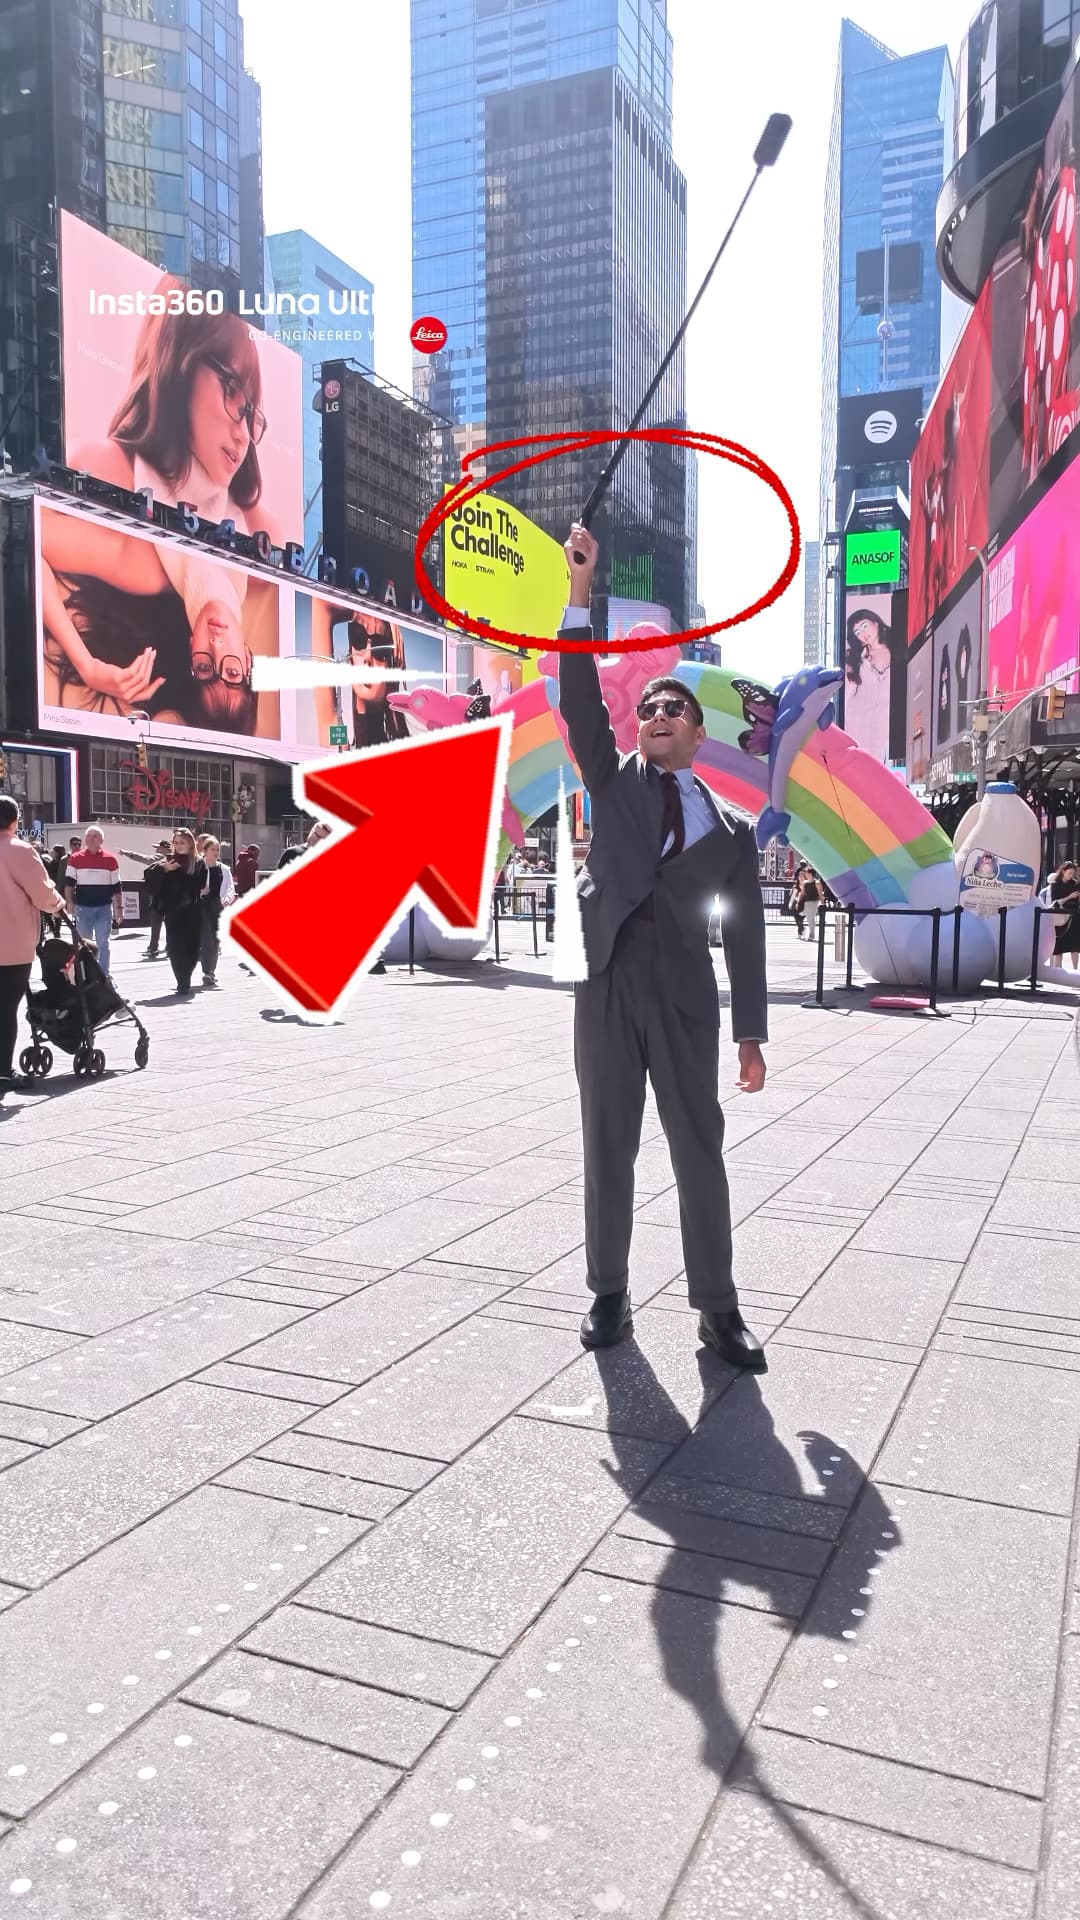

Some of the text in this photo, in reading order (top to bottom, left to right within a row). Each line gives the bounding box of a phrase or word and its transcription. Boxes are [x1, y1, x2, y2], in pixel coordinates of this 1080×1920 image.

[325, 401, 340, 414] LG
[450, 501, 519, 542] Join The
[450, 524, 525, 576] Challenge
[451, 560, 468, 569] HOKA
